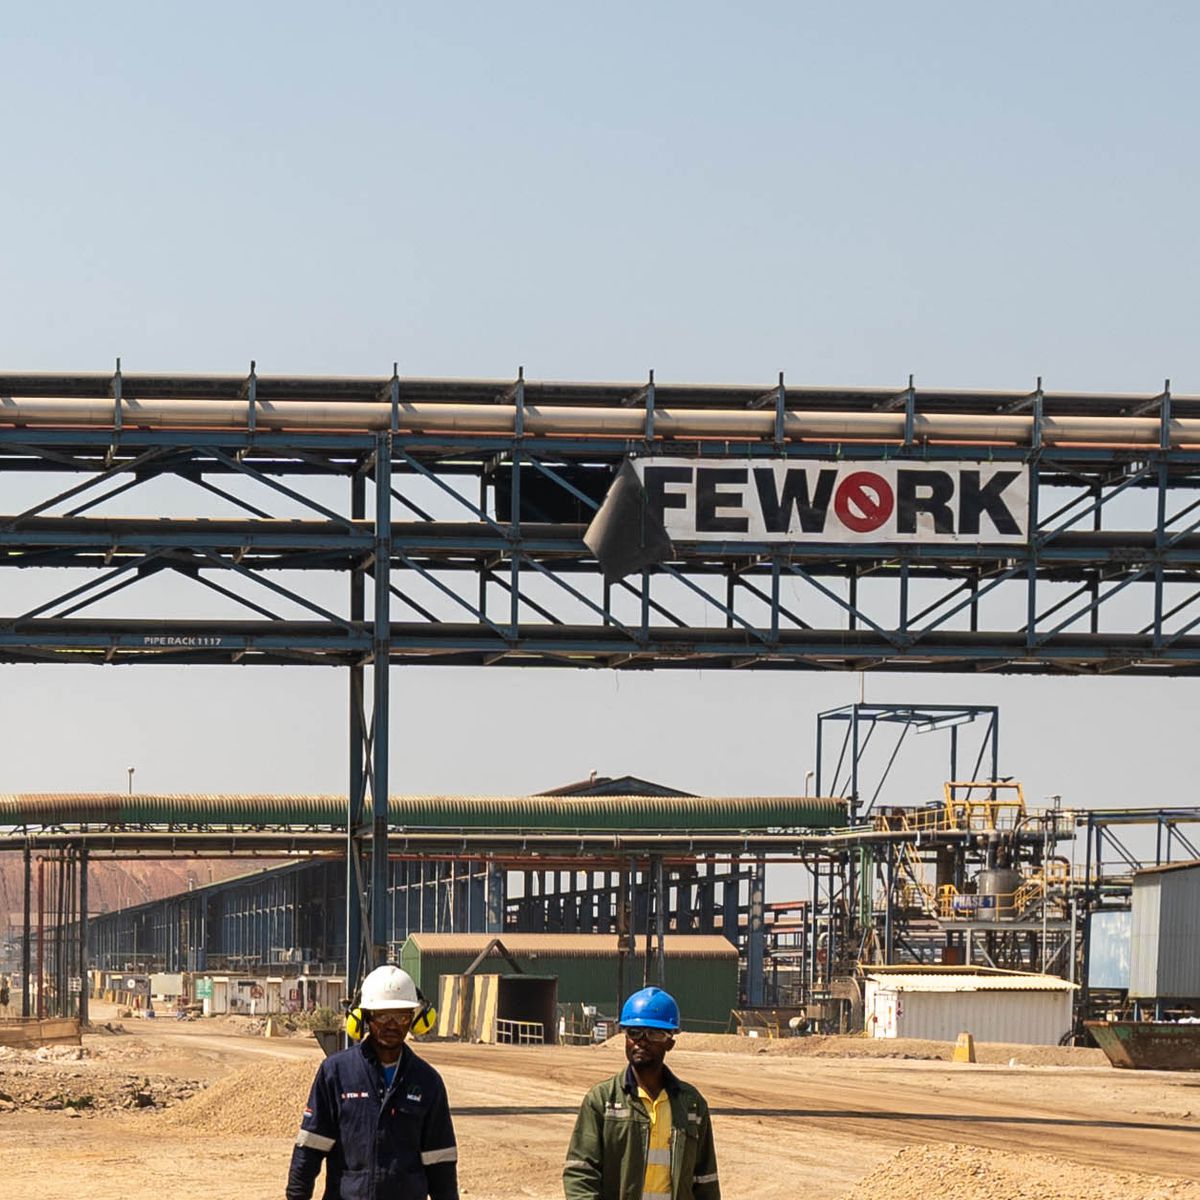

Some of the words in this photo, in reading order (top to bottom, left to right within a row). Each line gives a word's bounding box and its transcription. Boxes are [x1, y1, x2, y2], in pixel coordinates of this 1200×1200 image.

[144, 636, 166, 645] PIPE
[167, 637, 195, 645] RACK
[198, 637, 221, 645] 1117
